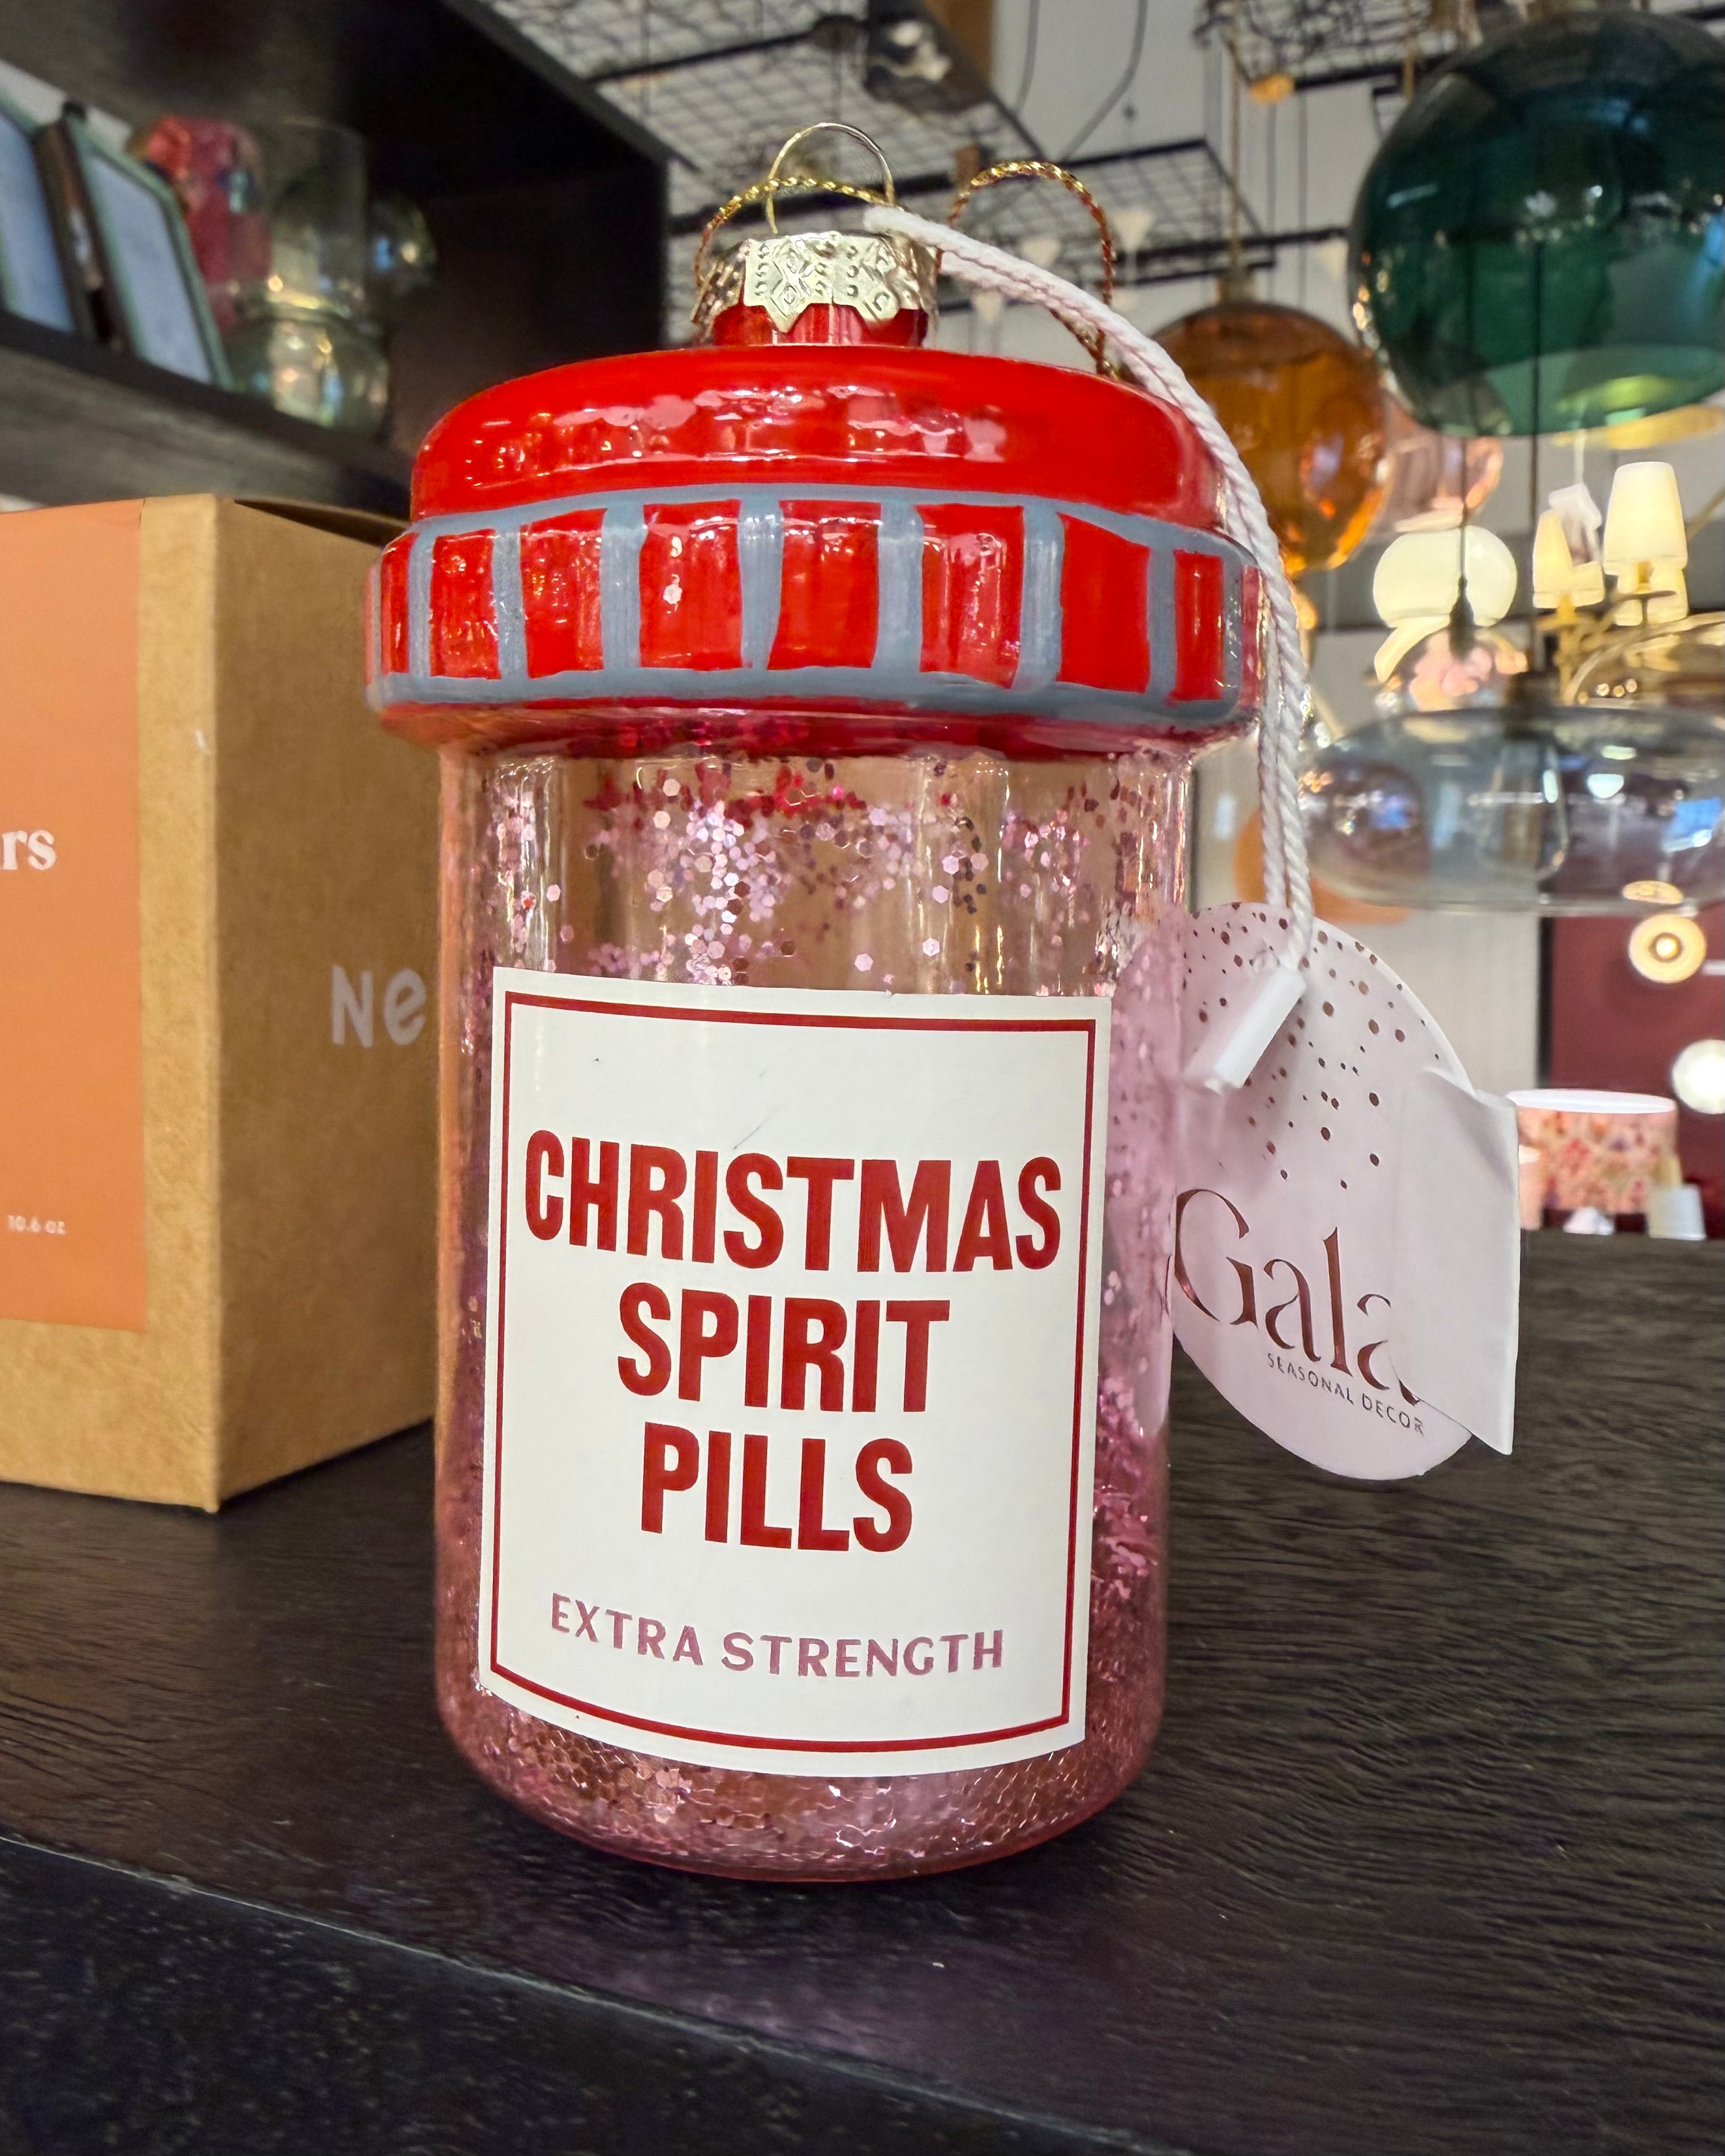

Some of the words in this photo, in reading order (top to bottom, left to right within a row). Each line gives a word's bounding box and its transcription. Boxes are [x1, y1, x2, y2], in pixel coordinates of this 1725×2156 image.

[331, 965, 427, 1048] Ne
[525, 1129, 1062, 1273] CHRISTMAS
[617, 1282, 951, 1413] SPIRIT
[1174, 1188, 1420, 1406] Gala
[1267, 1352, 1355, 1406] SEASONAL
[1362, 1392, 1424, 1437] DECOR
[640, 1421, 914, 1553] PILLS
[550, 1593, 704, 1667] EXTRA
[720, 1629, 1004, 1678] STRENGTH
